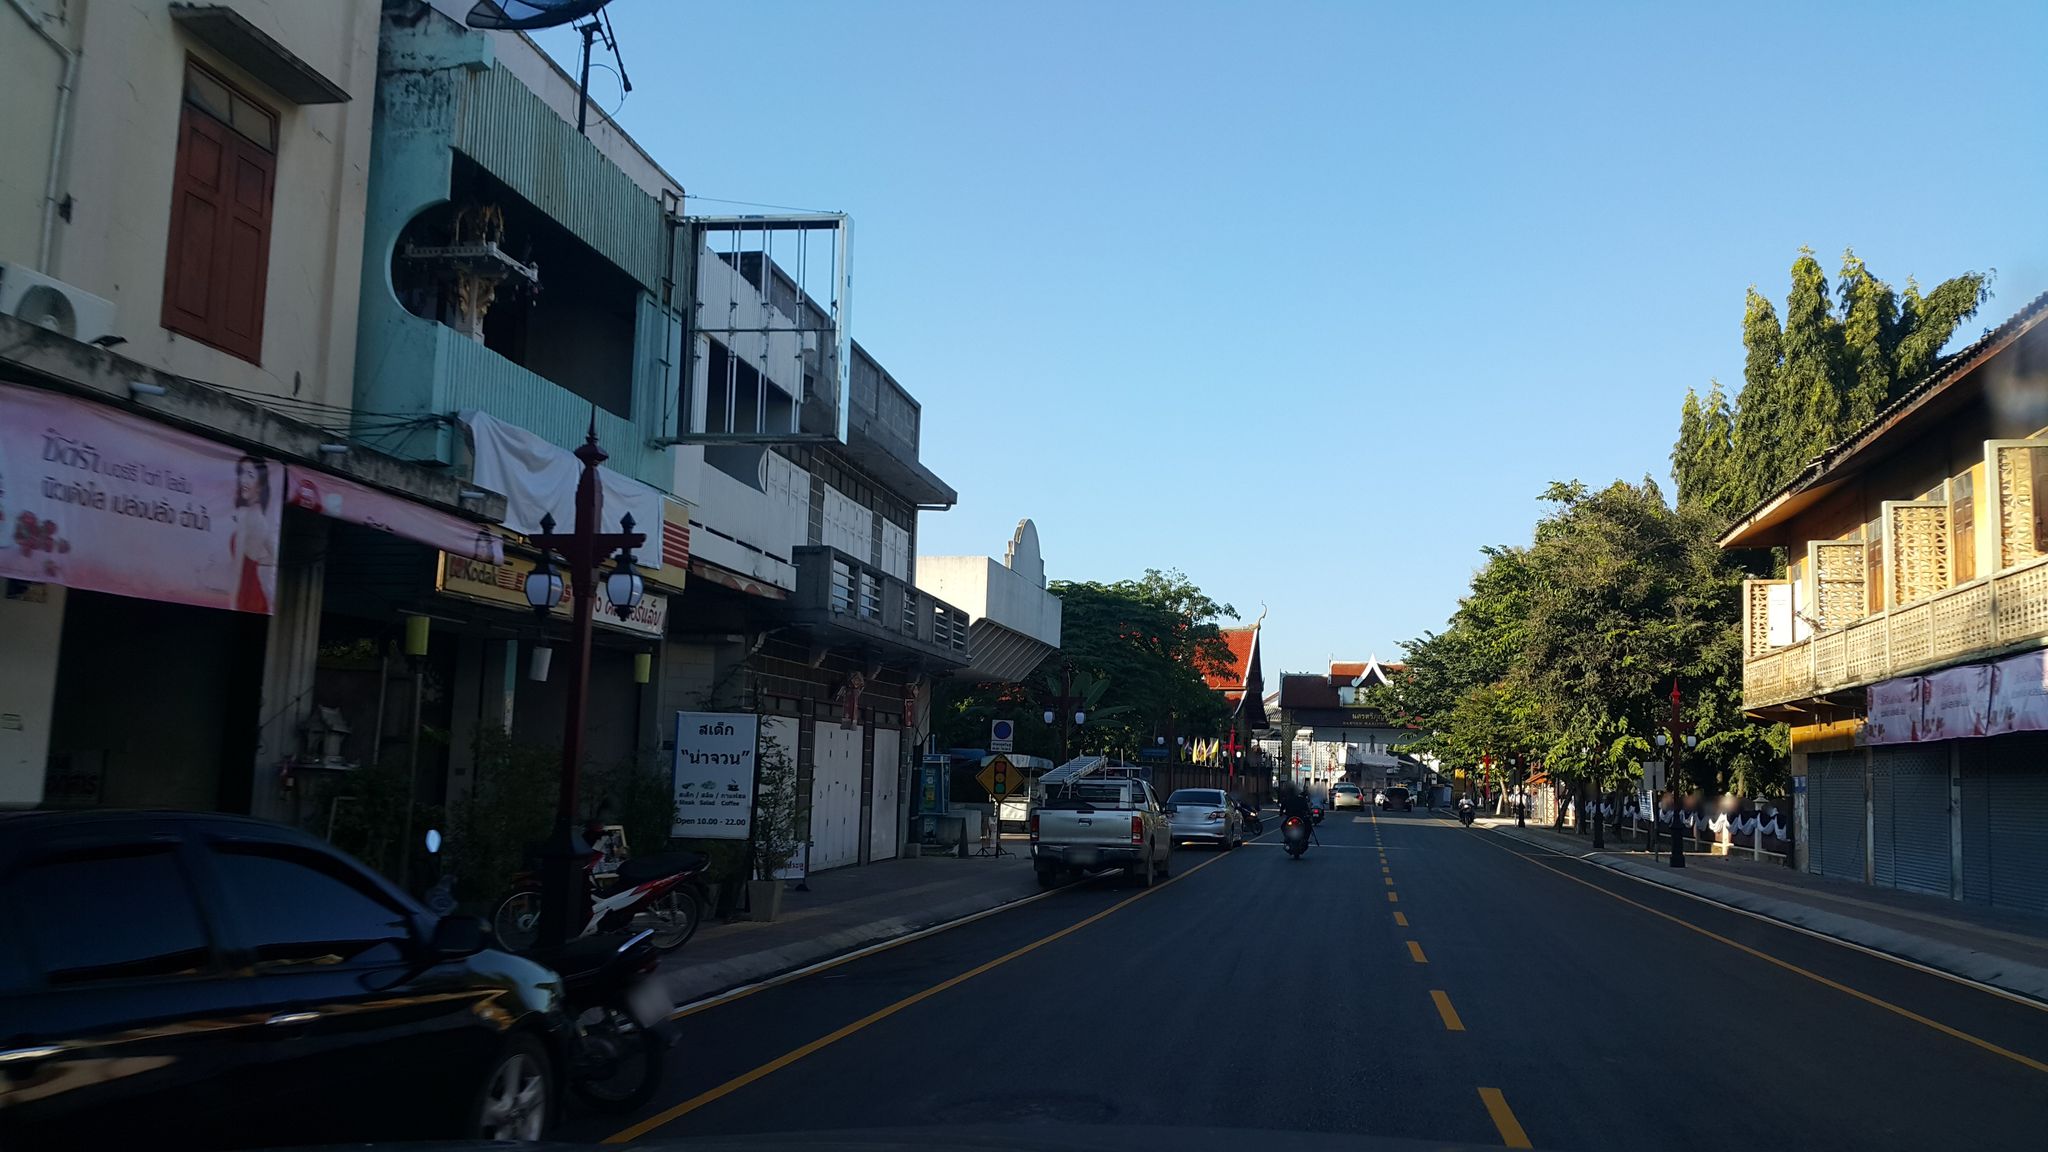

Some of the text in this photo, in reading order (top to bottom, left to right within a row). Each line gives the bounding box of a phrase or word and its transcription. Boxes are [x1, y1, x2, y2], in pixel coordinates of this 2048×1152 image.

[463, 559, 499, 586] Kodak
[675, 817, 695, 826] Open
[697, 817, 718, 825] 10.00
[725, 818, 746, 826] 22.00
